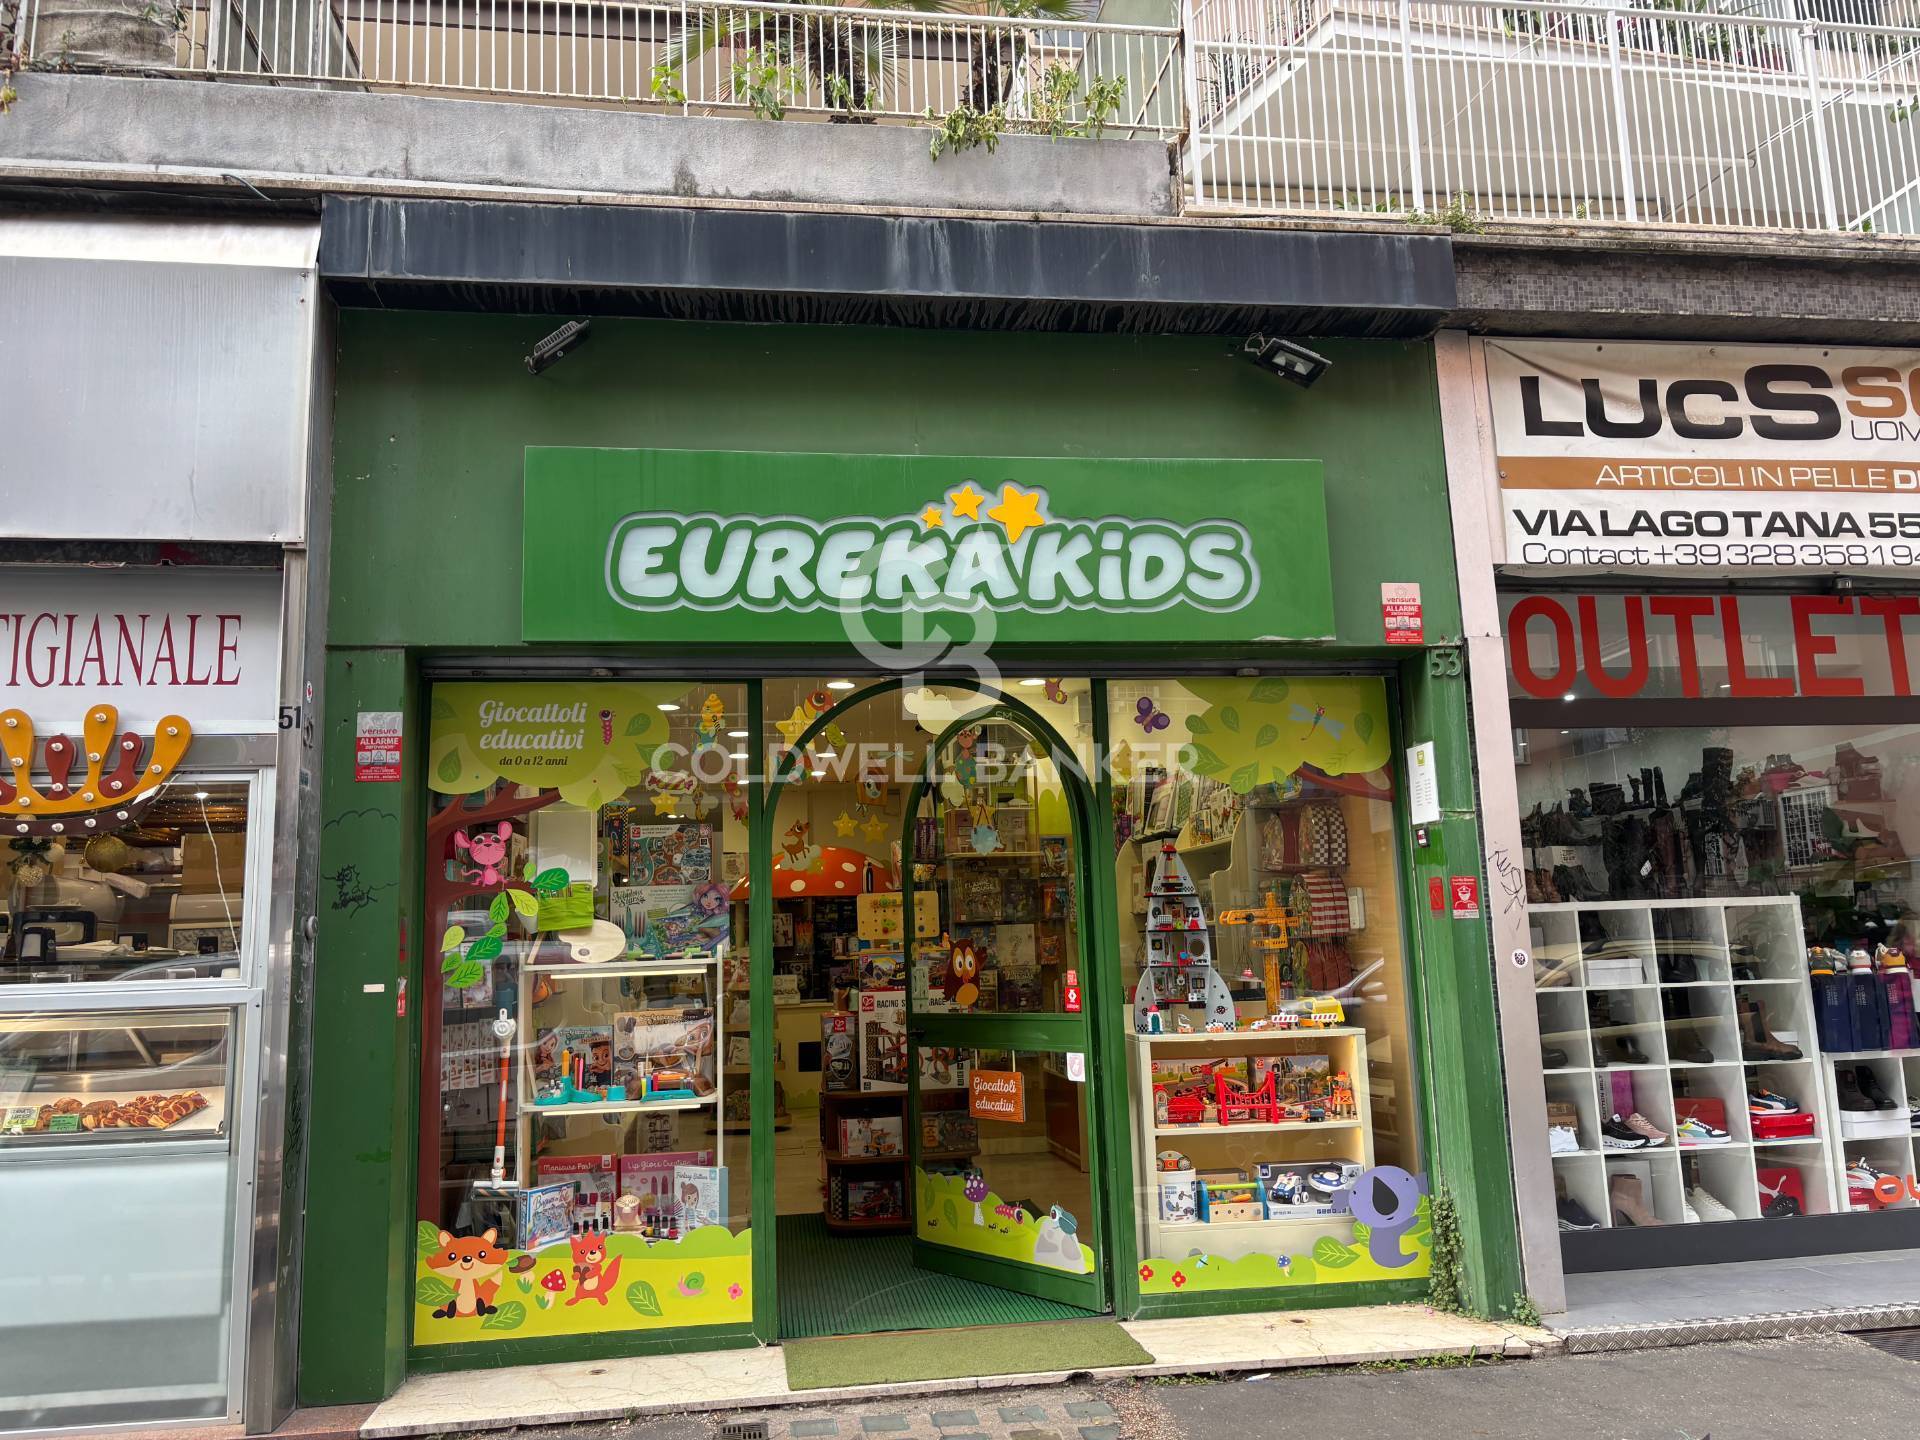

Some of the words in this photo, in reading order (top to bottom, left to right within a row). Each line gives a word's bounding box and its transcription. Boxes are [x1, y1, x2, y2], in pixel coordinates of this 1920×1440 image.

[1841, 366, 1920, 419] S
[1595, 465, 1745, 487] ARTICOLI
[1750, 466, 1783, 487] IN
[1789, 468, 1888, 488] PELLE
[1512, 509, 1597, 537] VIA
[1600, 509, 1729, 537] LAGO
[1731, 511, 1866, 538] TANA
[1522, 543, 1650, 566] Contact
[1654, 543, 1722, 566] +39
[1726, 544, 1796, 566] 328
[1800, 544, 1920, 566] 35819
[1507, 596, 1920, 698] OUTLET
[1430, 648, 1462, 677] 53
[279, 706, 301, 730] 51
[479, 699, 588, 728] Giocattoli
[360, 737, 400, 745] ALLARME
[479, 728, 585, 749] educativi
[499, 756, 513, 766] da
[514, 755, 523, 766] 0
[523, 757, 532, 766] a
[532, 755, 543, 766] 12
[545, 756, 569, 766] anni
[876, 999, 899, 1008] RACING
[973, 1077, 1017, 1095] Giocattoli
[975, 1096, 1016, 1113] educativi
